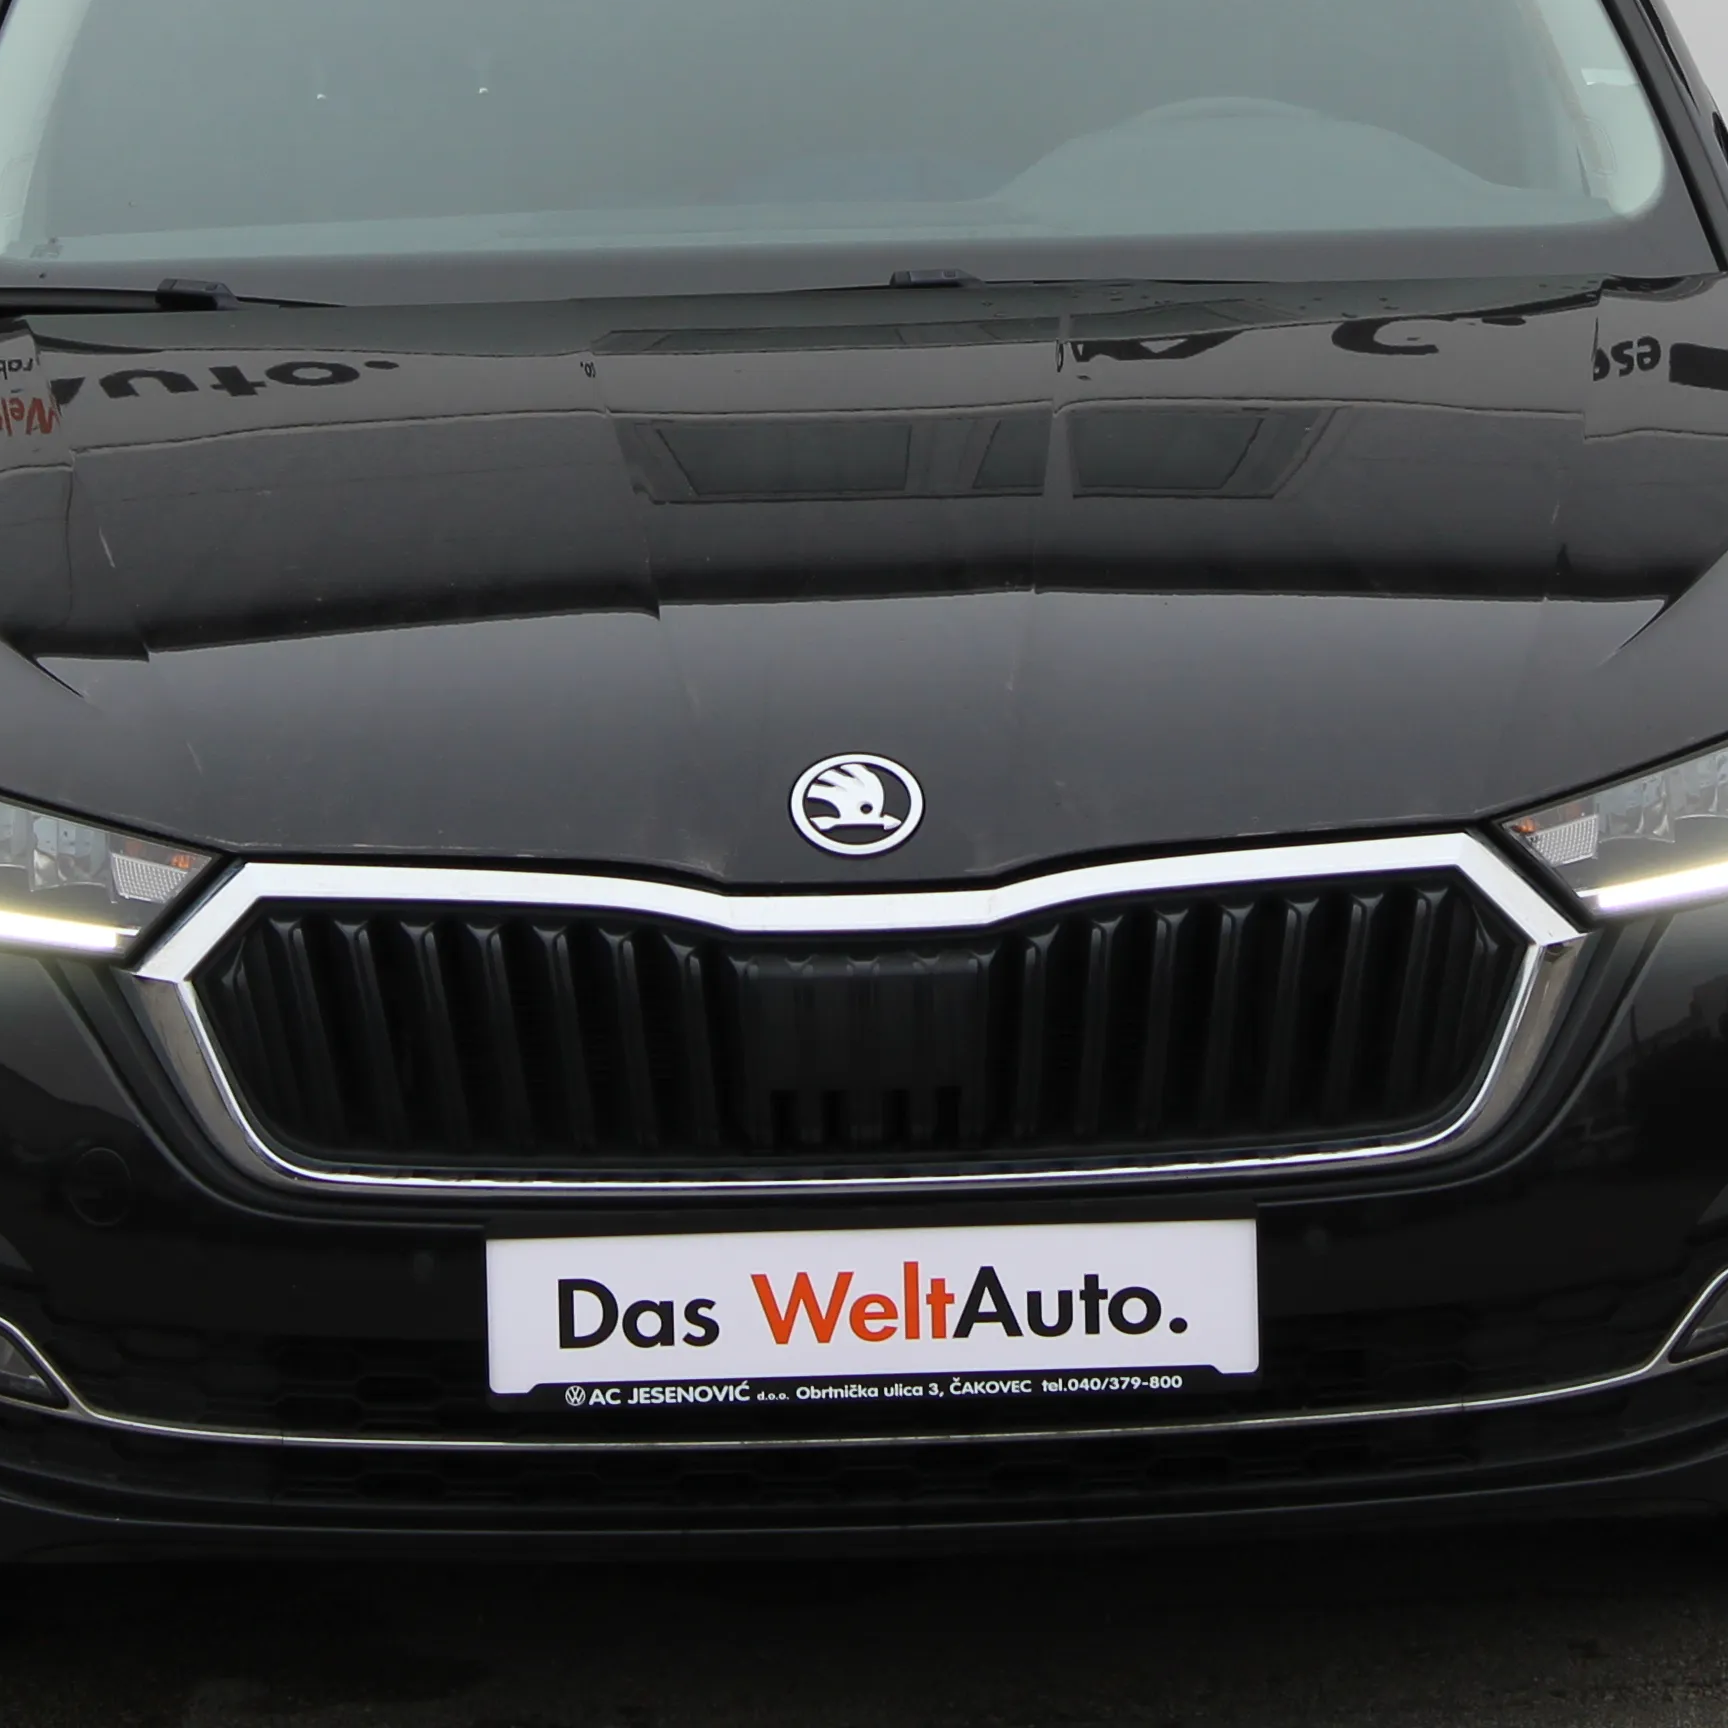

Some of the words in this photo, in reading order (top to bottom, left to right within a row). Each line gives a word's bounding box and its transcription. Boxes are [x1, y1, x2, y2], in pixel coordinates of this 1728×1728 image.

[557, 1278, 720, 1350] Das
[750, 1261, 1188, 1345] WeltAuto.
[588, 1388, 622, 1406] AC
[627, 1379, 751, 1405] JESENOVIĆ
[756, 1390, 790, 1402] d.o.o.
[795, 1382, 879, 1401] Obrtnička
[883, 1382, 924, 1398] ulica
[928, 1382, 945, 1398] 3,
[949, 1376, 1033, 1396] ČAKOVEC
[1041, 1374, 1183, 1393] tel.040/379-800
